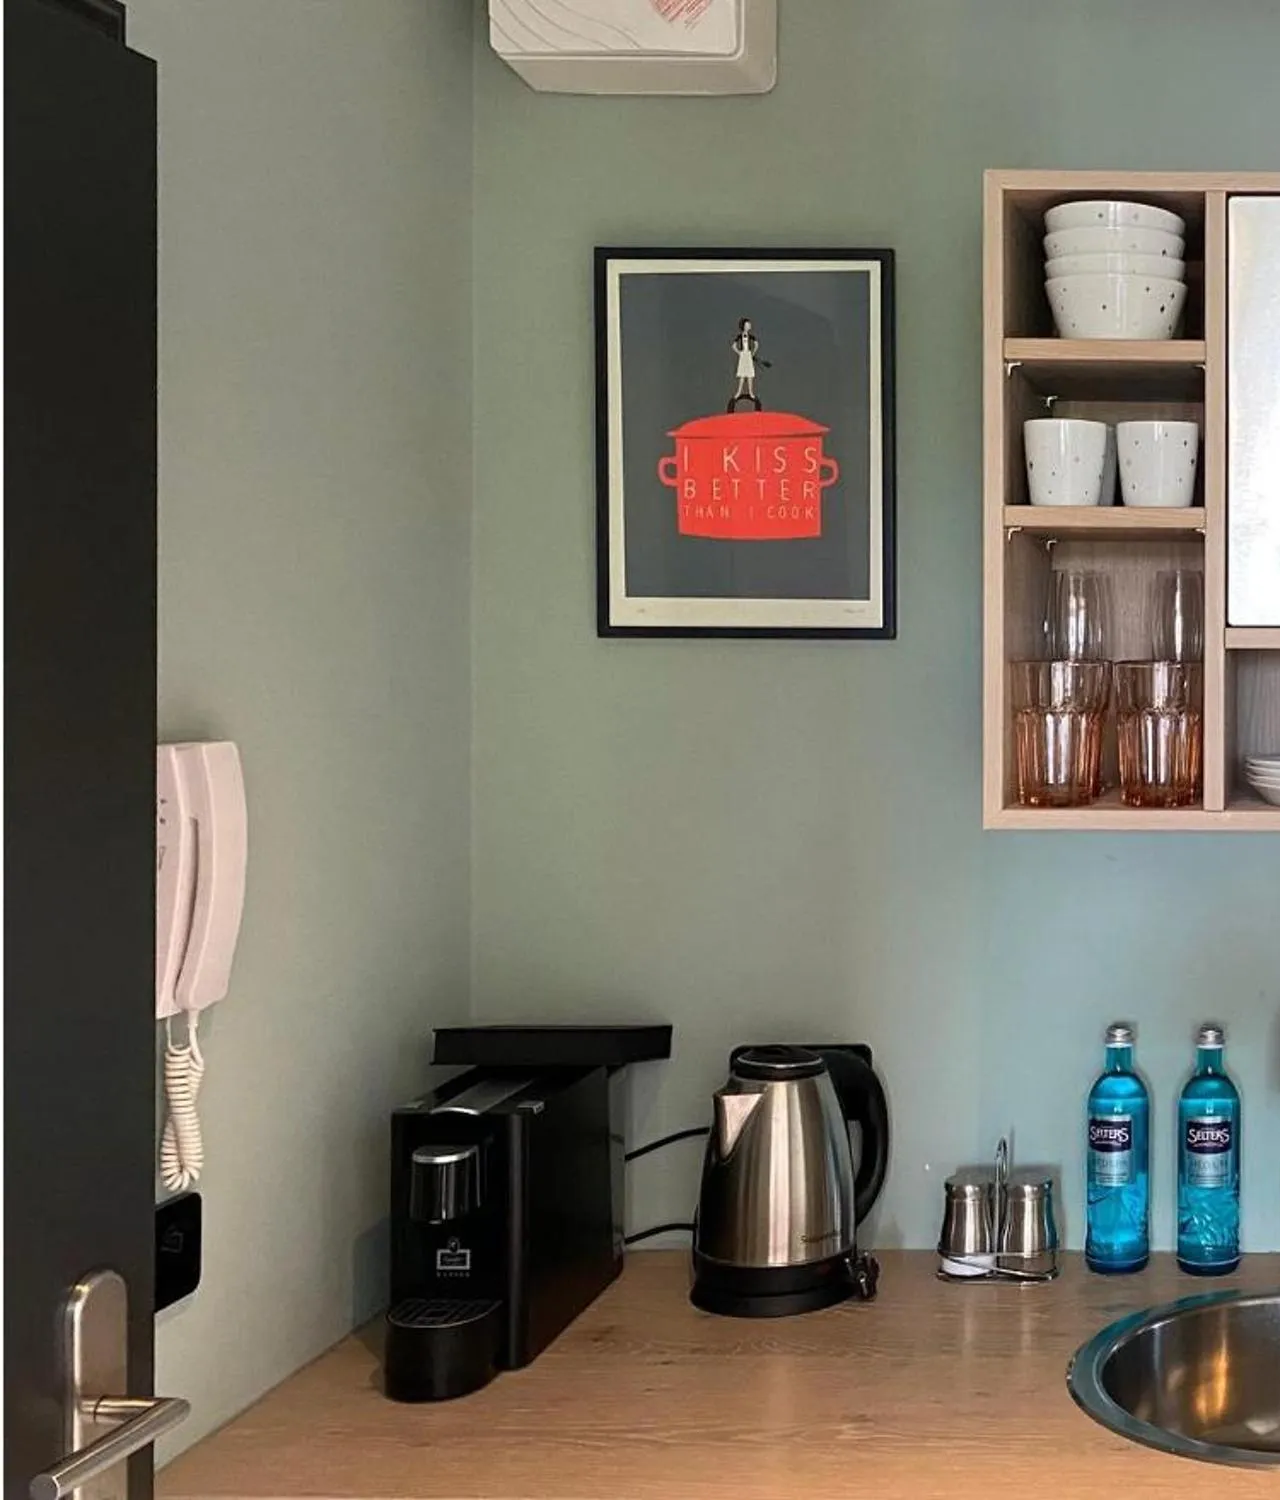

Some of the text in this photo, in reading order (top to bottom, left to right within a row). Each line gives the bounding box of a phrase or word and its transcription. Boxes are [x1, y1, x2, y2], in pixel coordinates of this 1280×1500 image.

[683, 444, 818, 474] I KISS
[683, 478, 816, 501] BETTER
[683, 504, 731, 520] THAN
[766, 505, 815, 520] COOK
